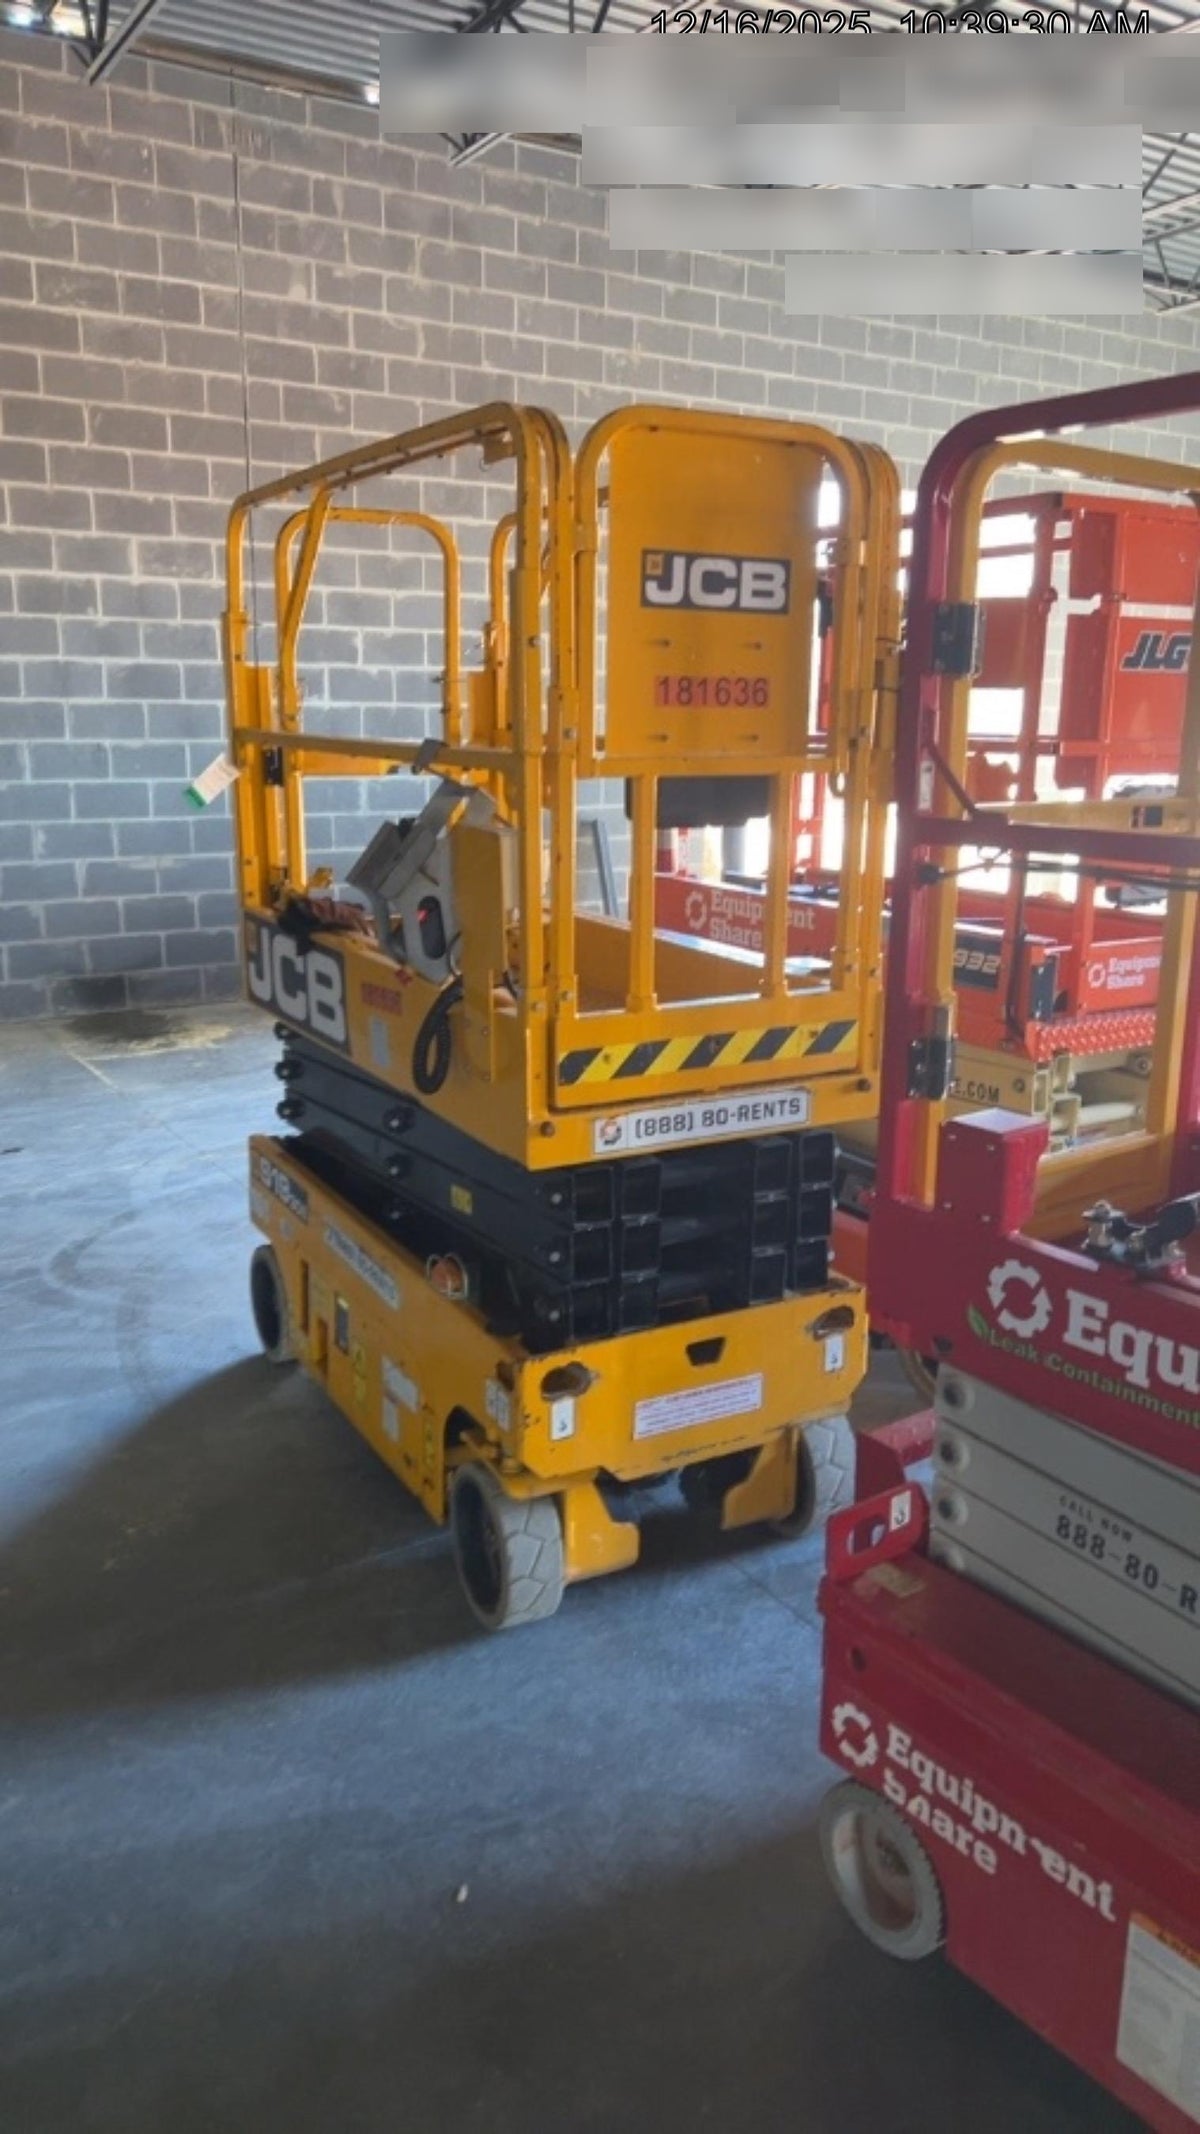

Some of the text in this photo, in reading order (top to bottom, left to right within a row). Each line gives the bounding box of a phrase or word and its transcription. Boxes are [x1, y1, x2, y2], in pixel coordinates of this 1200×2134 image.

[644, 555, 787, 611] JCB
[1121, 631, 1192, 672] JLG
[658, 676, 769, 707] 181636
[710, 889, 817, 931] Equipent
[952, 947, 1001, 975] 932
[248, 925, 346, 1042] JCB
[952, 1077, 1000, 1103] E.COM
[701, 1096, 801, 1128] 80-RENTS
[1062, 1287, 1200, 1396] Equ
[990, 1328, 1200, 1429] Leak Containment
[1056, 1514, 1199, 1614] 888-80-R
